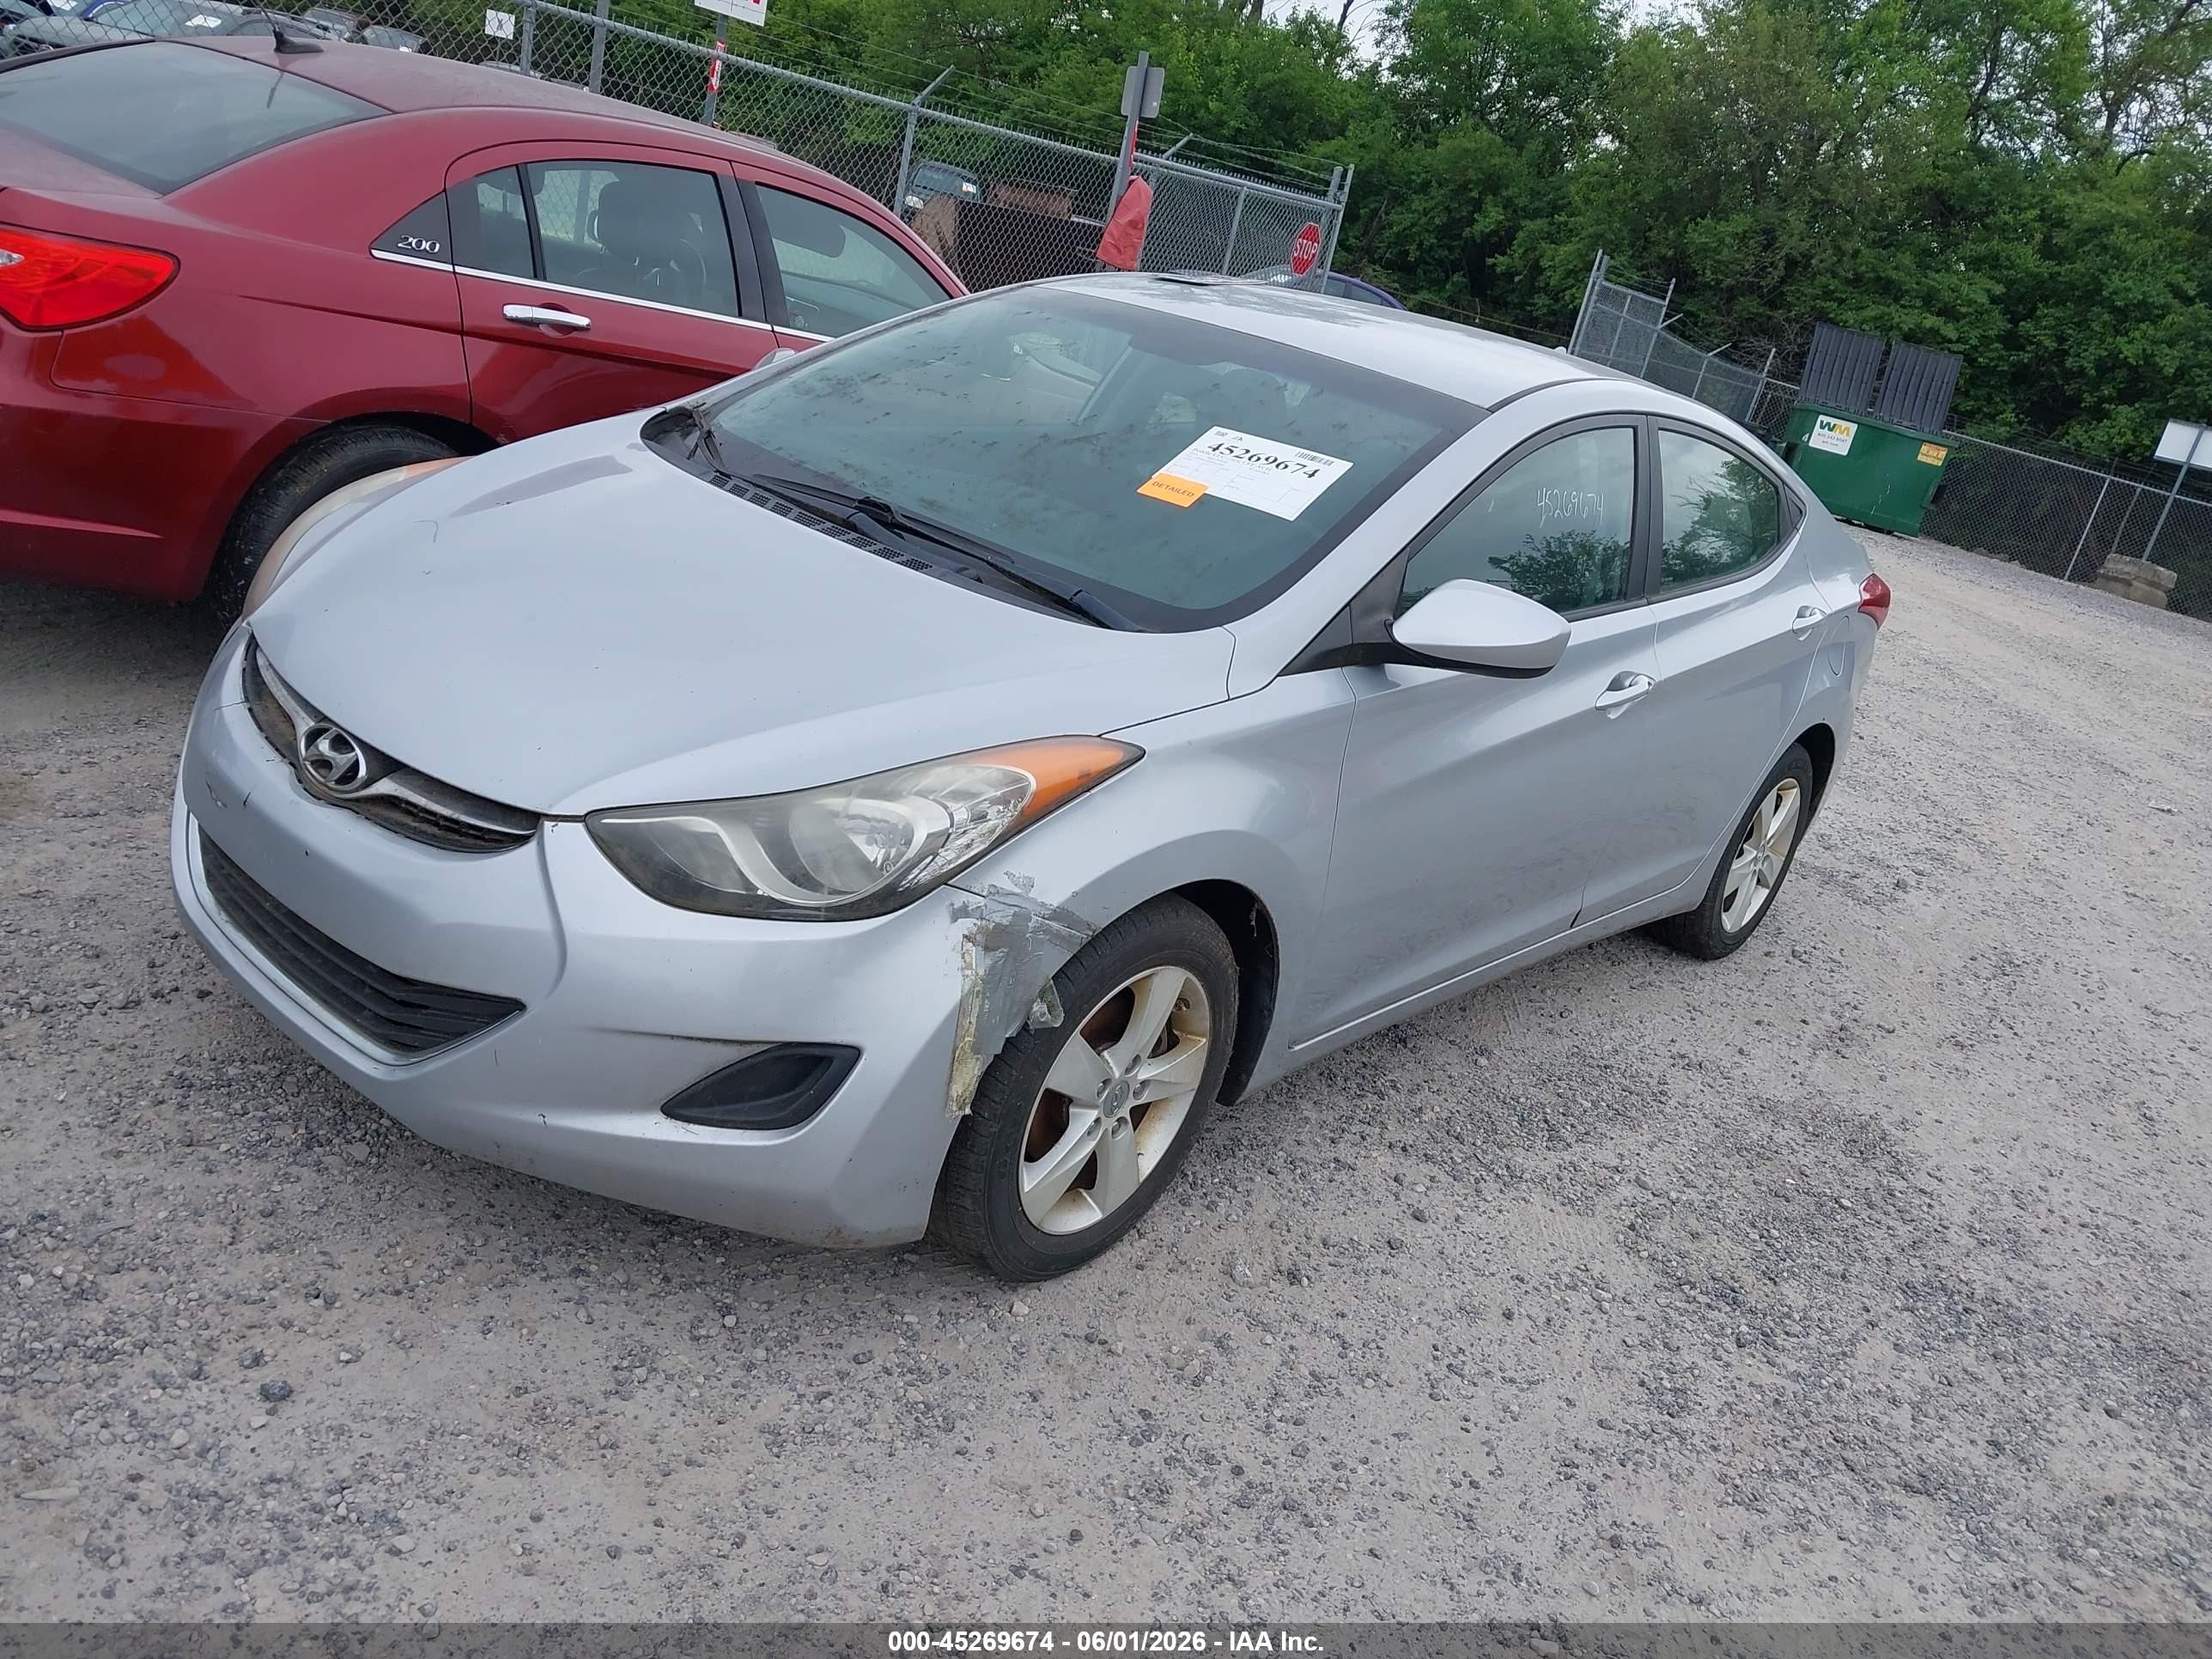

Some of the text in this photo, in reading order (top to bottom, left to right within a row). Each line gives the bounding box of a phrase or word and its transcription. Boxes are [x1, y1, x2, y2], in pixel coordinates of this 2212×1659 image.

[398, 235, 440, 253] 200
[1294, 239, 1317, 261] STOP
[1820, 420, 1850, 436] WM
[1207, 442, 1322, 478] 45269674
[1152, 481, 1195, 497] DETAILED
[1537, 488, 1603, 528] 45269674
